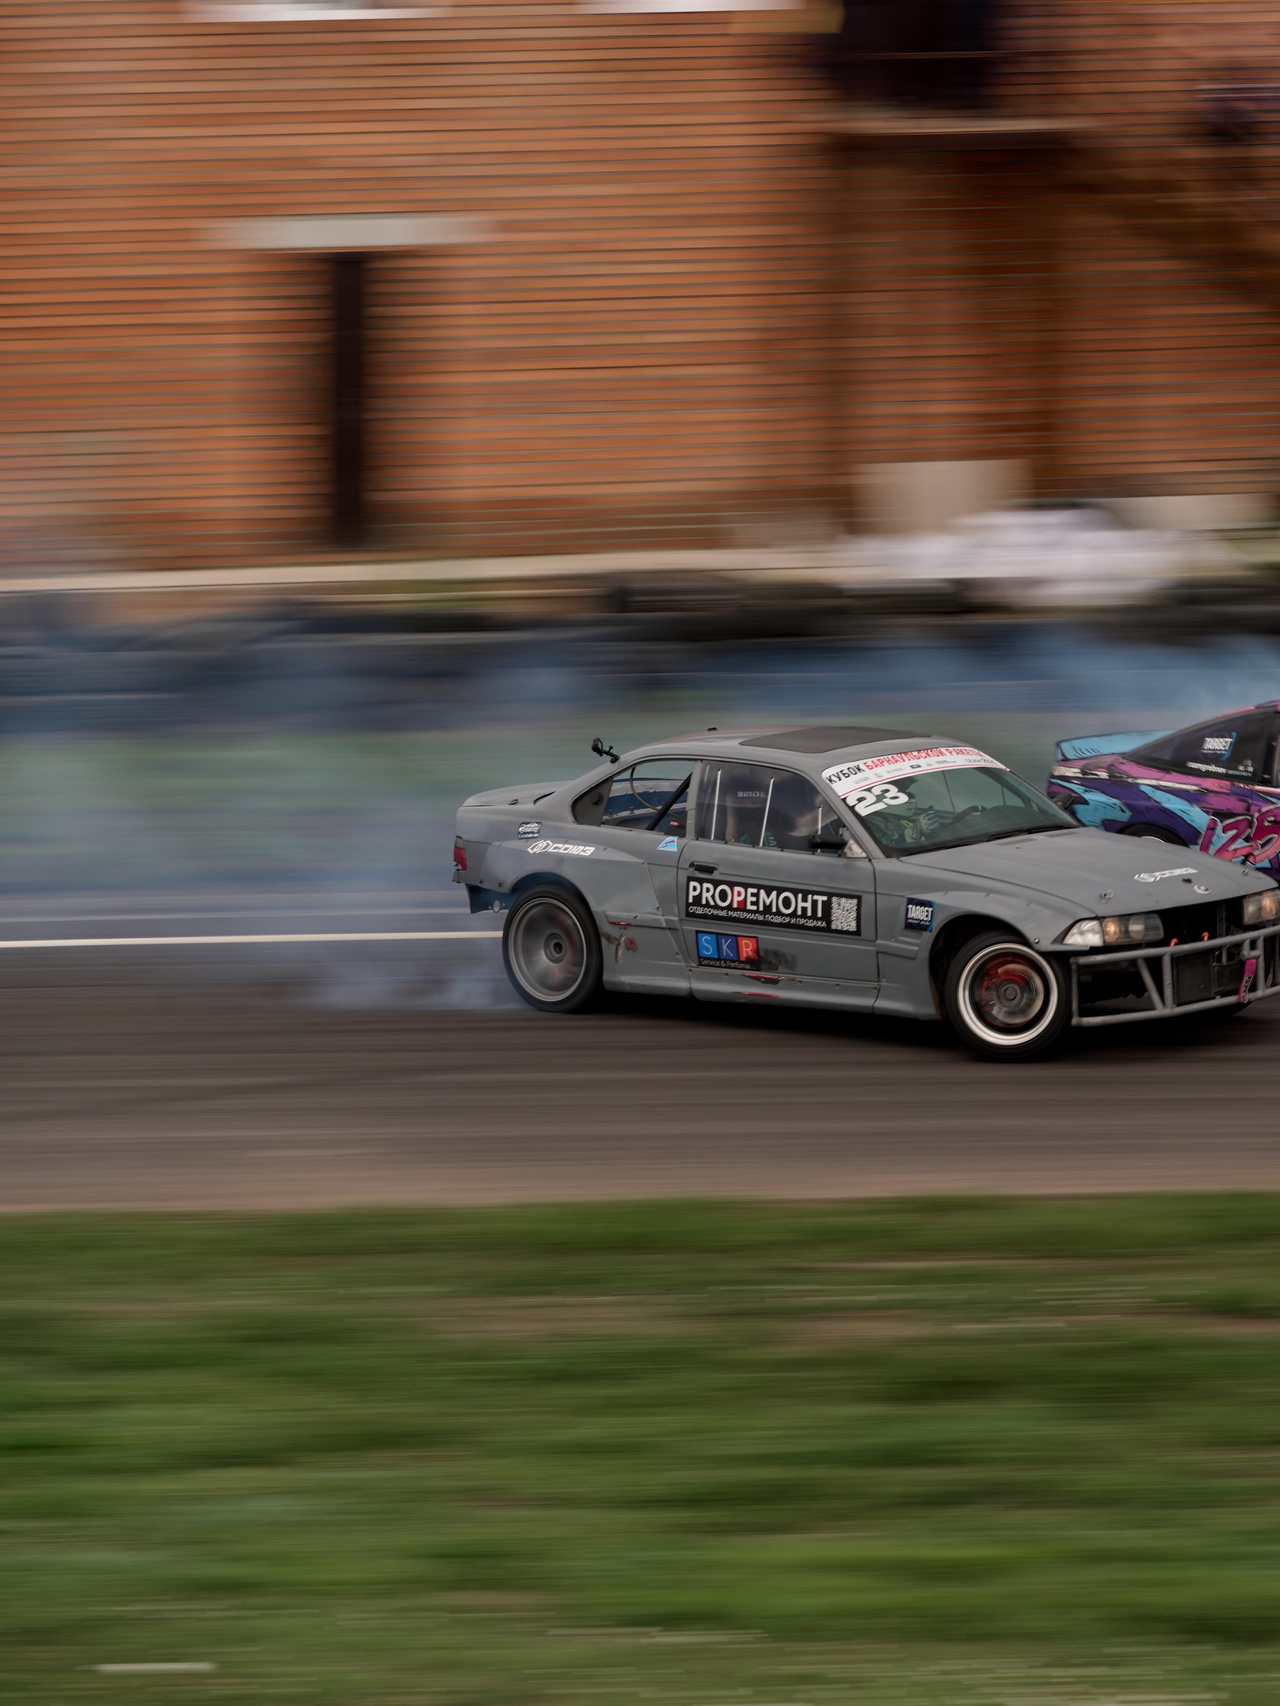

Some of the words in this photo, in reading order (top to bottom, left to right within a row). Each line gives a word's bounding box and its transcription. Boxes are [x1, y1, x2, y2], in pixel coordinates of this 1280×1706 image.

[1202, 737, 1233, 751] TARGET
[825, 764, 865, 785] КУБОК
[863, 748, 945, 771] БАРНАУЛЬСКОЙ
[845, 783, 909, 817] 23
[549, 843, 596, 856] СОЮЗ
[688, 905, 728, 917] ОТДЕЛОЧНЫЕ
[765, 914, 790, 924] ПОДБОР
[797, 918, 827, 928] ПРОДАЖА
[907, 904, 934, 921] TARGET
